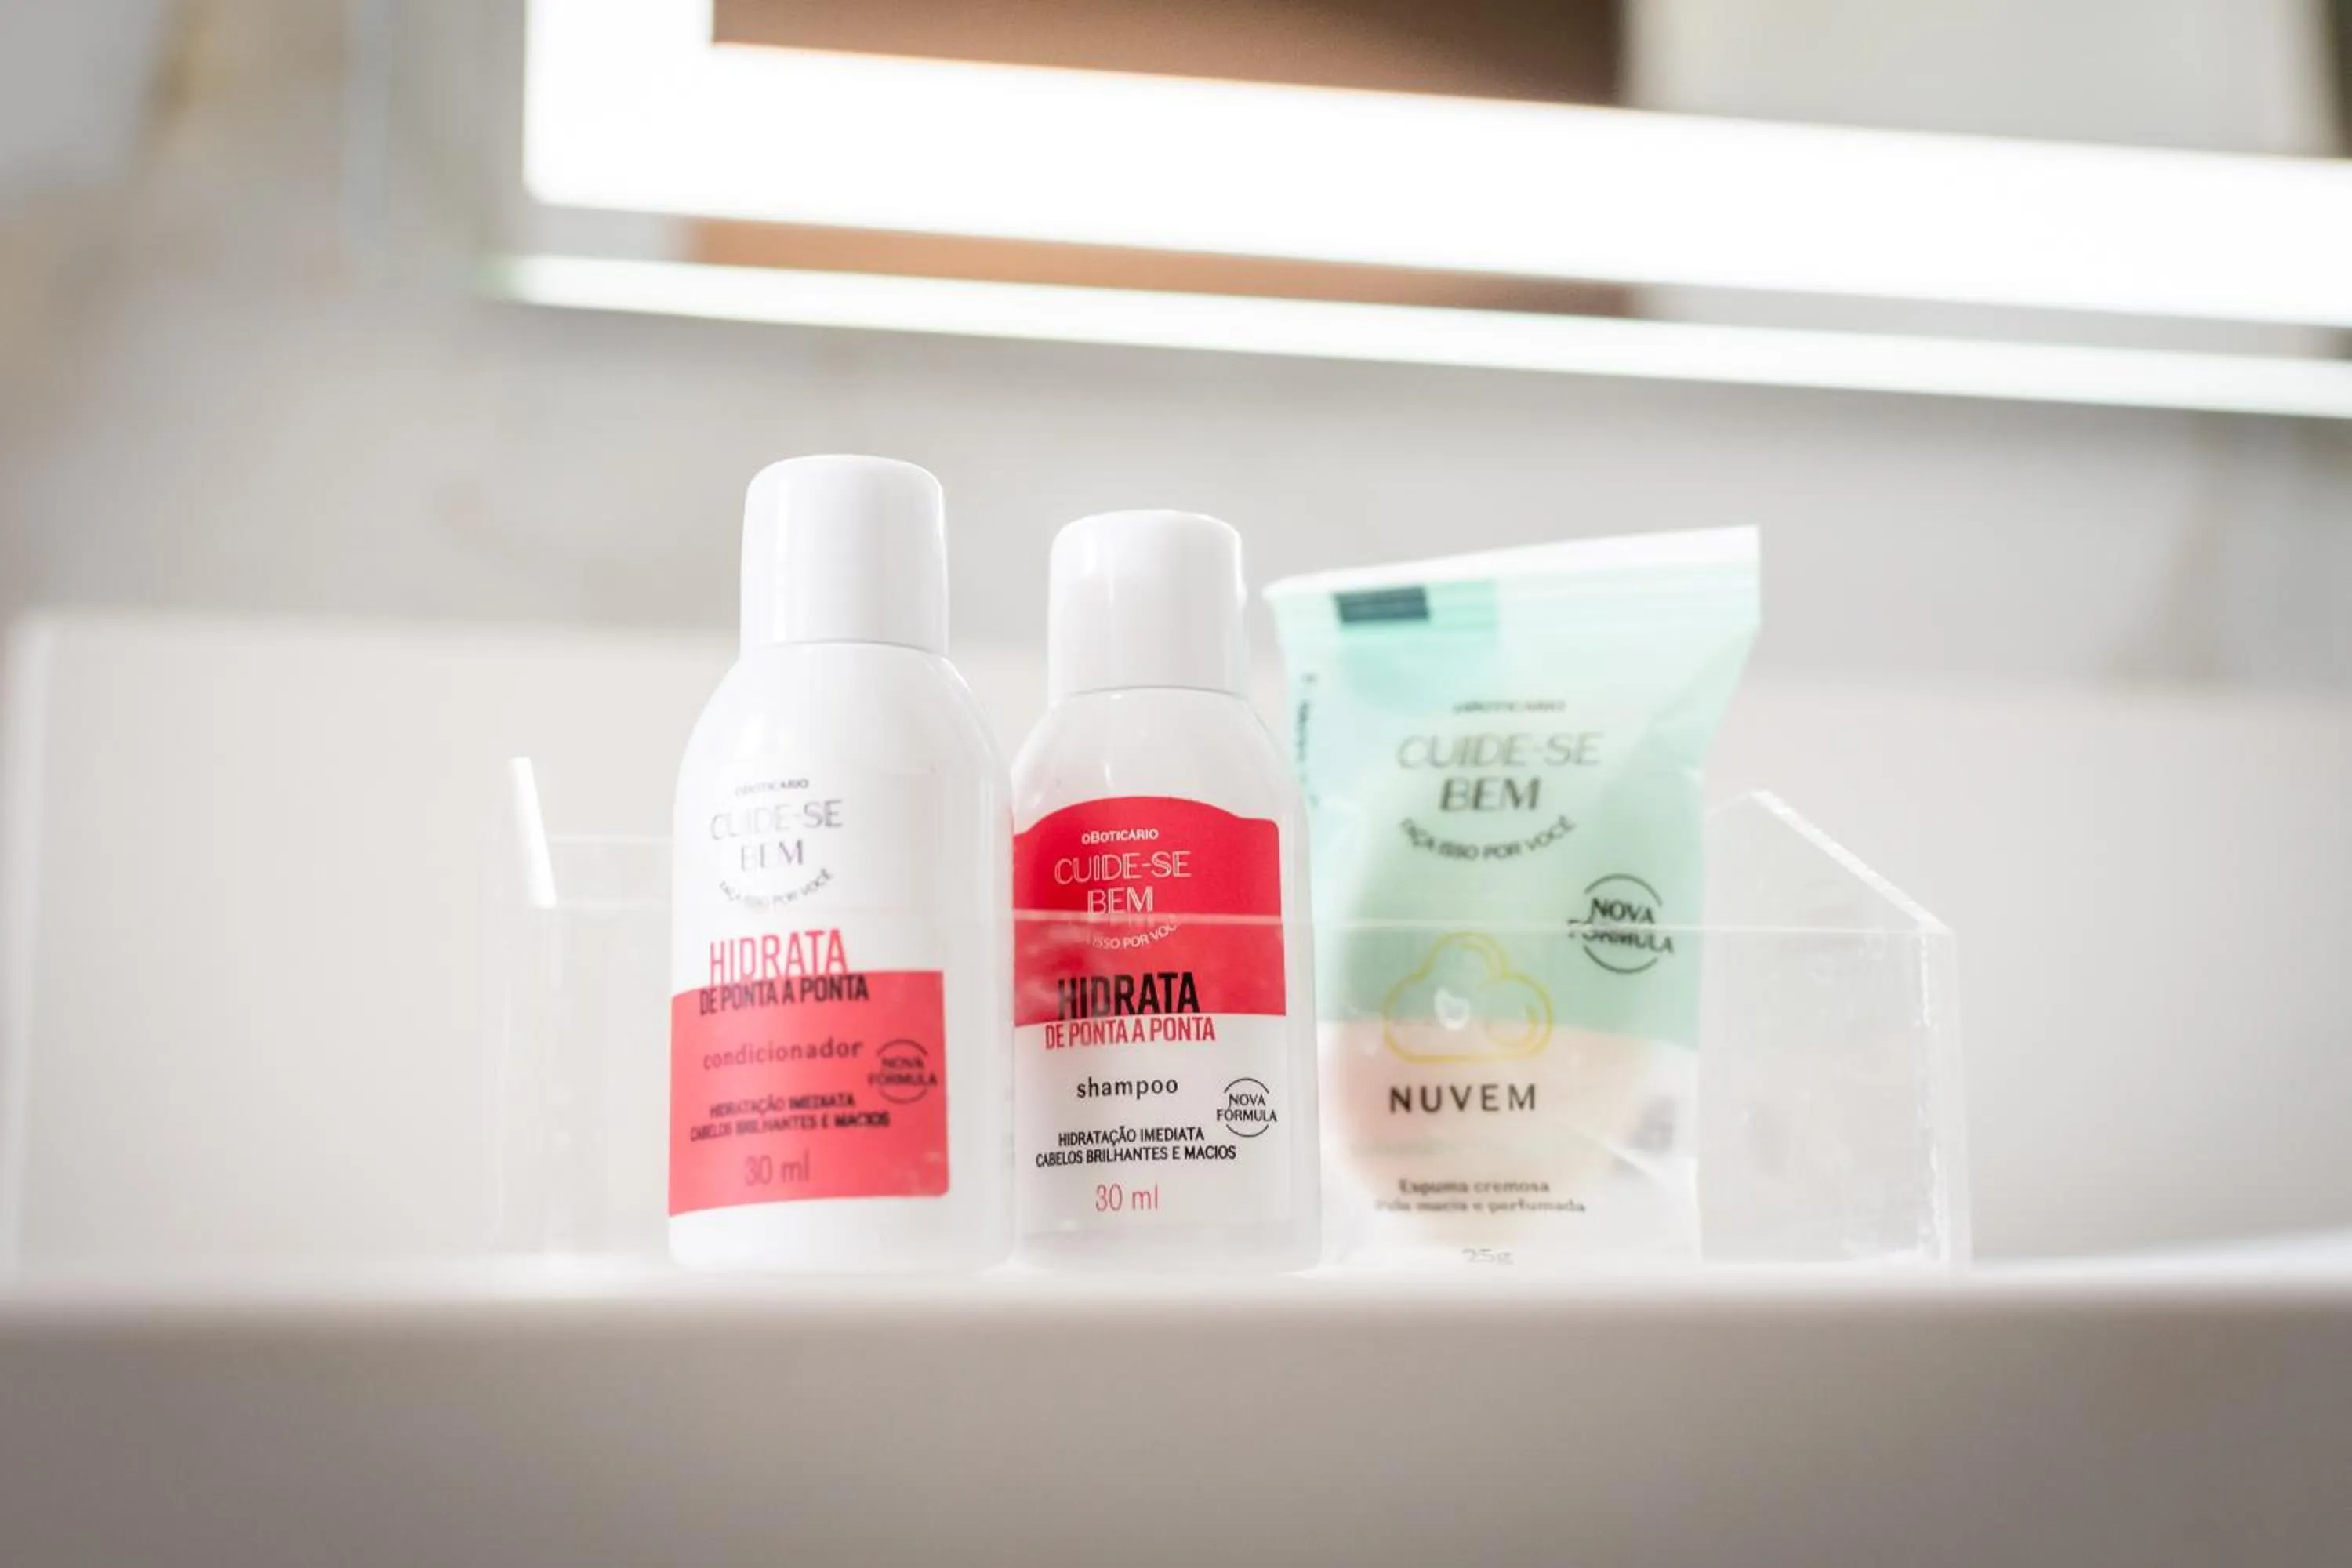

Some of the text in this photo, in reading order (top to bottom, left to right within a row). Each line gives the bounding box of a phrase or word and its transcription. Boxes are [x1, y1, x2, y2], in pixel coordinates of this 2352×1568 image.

[1396, 731, 1603, 769] CUIDE-SE
[1438, 775, 1542, 813] BEM
[1054, 850, 1192, 885] CUIDE-SE
[1087, 886, 1153, 915] BEM
[1591, 897, 1656, 924] NOVA
[1123, 933, 1151, 949] POR
[710, 928, 849, 985] HIDRATA
[699, 973, 869, 1015] DE PONTA A PONTA
[1058, 971, 1200, 1019] HIDRATA
[1045, 1016, 1216, 1050] DE PONTA A PONTA
[703, 1036, 864, 1069] condicionador
[1076, 1077, 1178, 1099] shampoo
[1228, 1093, 1266, 1107] NOVA
[1389, 1083, 1537, 1114] NUVEM
[1058, 1127, 1204, 1147] HIDRATAÇÃO IMEDIATA
[745, 1149, 811, 1186] 30 ml
[1036, 1145, 1236, 1167] CABELOS BRILHANTES E MACIOS
[1095, 1183, 1159, 1212] 30 ml
[1474, 1179, 1550, 1193] cremosa
[1488, 1197, 1587, 1214] perfumada
